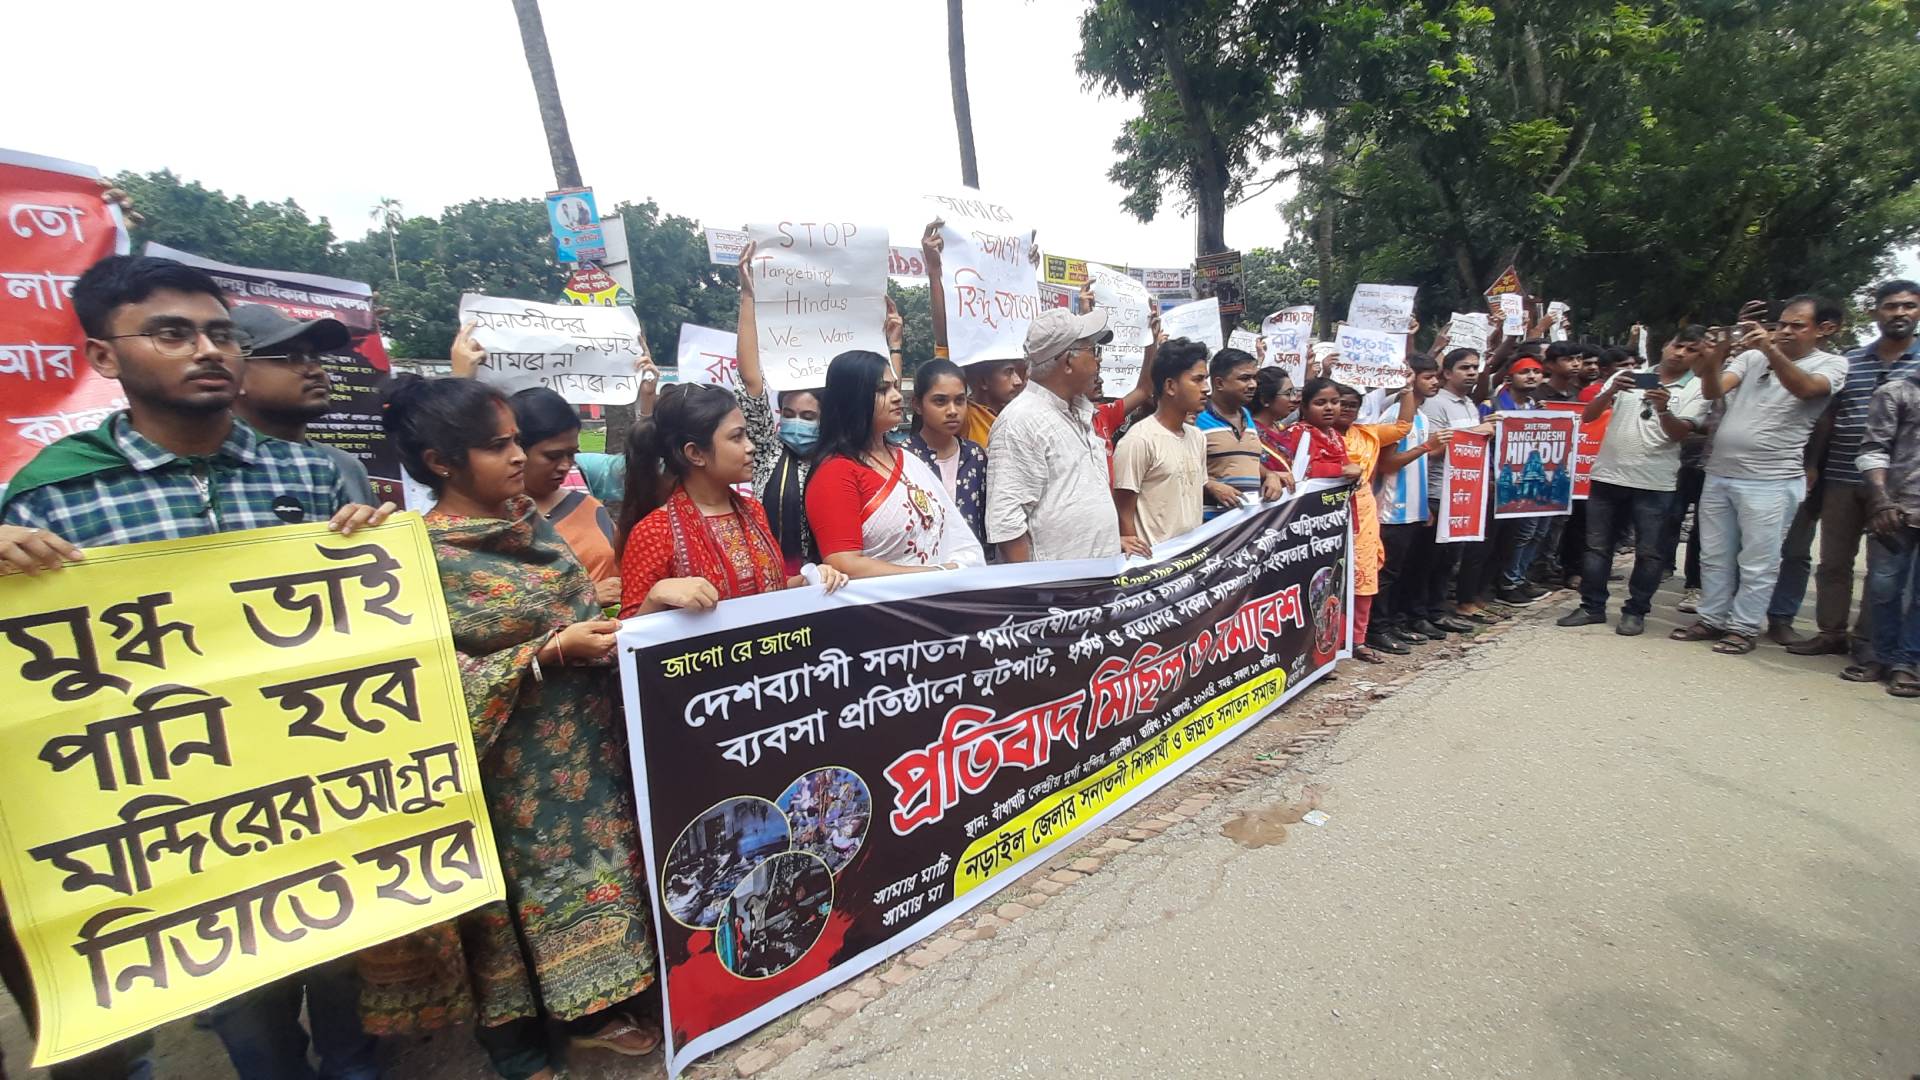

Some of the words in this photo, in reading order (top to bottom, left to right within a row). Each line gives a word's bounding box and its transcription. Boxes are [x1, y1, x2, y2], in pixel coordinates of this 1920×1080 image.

[8, 203, 86, 244] তো
[778, 221, 857, 248] STOP
[755, 256, 834, 287] Targeting
[250, 281, 309, 303] অধিকার
[309, 294, 372, 312] আন্দোলন
[786, 291, 848, 315] Hindus
[465, 309, 587, 333] সনাতনীদের
[769, 326, 802, 348] We
[819, 327, 855, 344] Want
[0, 340, 76, 382] আর
[551, 353, 577, 369] না
[571, 331, 638, 356] লড়াই
[611, 374, 638, 391] না
[1505, 441, 1566, 465] HINDU
[1507, 431, 1566, 442] BANGLADESHI
[0, 591, 204, 701] মুগ্ধ
[230, 543, 414, 647] ভাই
[661, 644, 724, 679] জাগো
[730, 640, 753, 663] রে
[757, 626, 812, 656] জাগো
[684, 647, 854, 728] দেশব্যাপী
[860, 634, 970, 676] সনাতন
[976, 606, 1102, 655] ধর্মাবলম্বীদের
[716, 708, 829, 767] ব্যবসা
[838, 673, 967, 730] প্রতিষ্ঠানে
[972, 647, 1057, 697] লুটপাট,
[1068, 630, 1104, 664] ধর্ষণ
[1106, 630, 1125, 647] ও
[1122, 605, 1182, 641] হত্যাসহ
[1176, 590, 1212, 618] সকল
[38, 684, 233, 792] পানি
[259, 657, 421, 742] হবে
[883, 690, 1086, 836] প্রতিবাদ
[1086, 642, 1187, 740] মিছিল
[1189, 630, 1213, 678] ও
[1208, 583, 1304, 667] সমাবেশ
[963, 828, 1027, 880] নড়াইল
[1031, 795, 1077, 844] জেলার
[1080, 760, 1129, 811] সনাতনী
[1129, 728, 1169, 781] শিক্ষার্থী
[1171, 731, 1182, 750] ও
[1183, 713, 1214, 744] জাগ্রত
[1216, 693, 1250, 725] সনাতন
[964, 815, 989, 838] স্থান:
[1028, 775, 1062, 802] কেন্দ্রীয়
[1064, 762, 1081, 785] দুর্গা
[27, 776, 322, 897] মন্দিরের
[317, 742, 462, 820] আগুন
[873, 872, 917, 905] আমার
[921, 851, 952, 883] মাটি
[72, 860, 354, 1009] নিভাতে
[353, 821, 483, 906] হবে
[882, 893, 922, 927] আমার
[927, 883, 945, 904] মা
